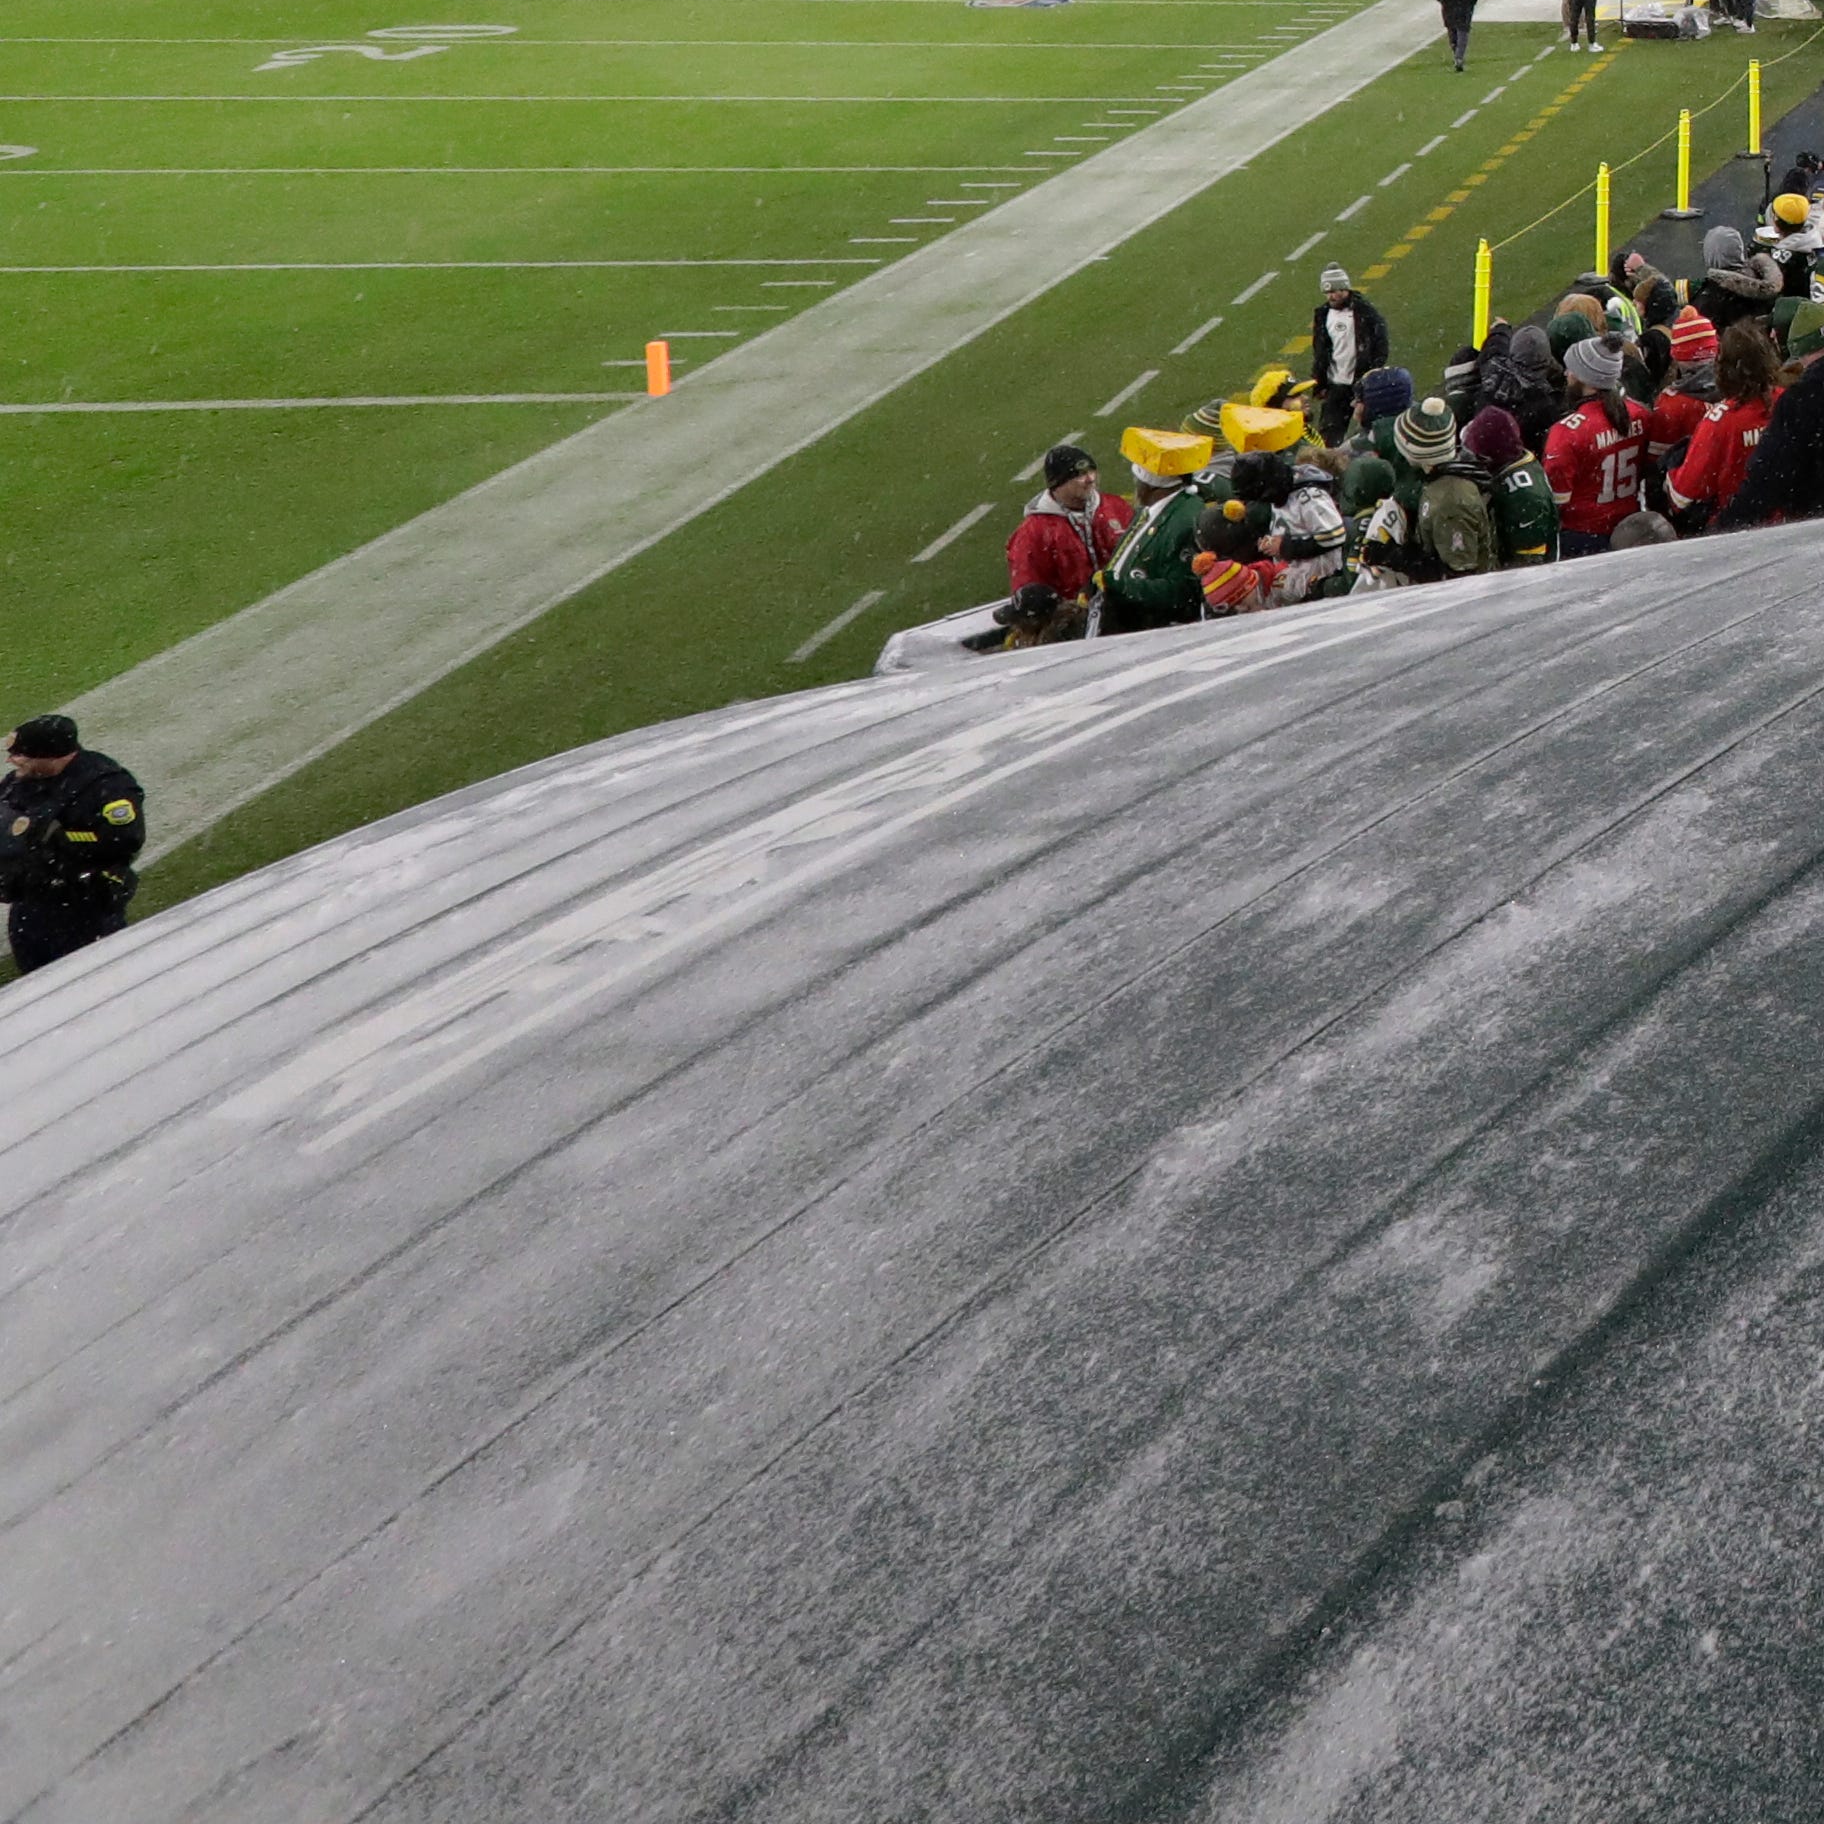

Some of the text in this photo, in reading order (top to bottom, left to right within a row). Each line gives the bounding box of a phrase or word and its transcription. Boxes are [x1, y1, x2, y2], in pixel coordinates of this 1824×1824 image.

[252, 24, 519, 73] 20
[1504, 468, 1534, 493] 10
[1597, 445, 1640, 504] 15
